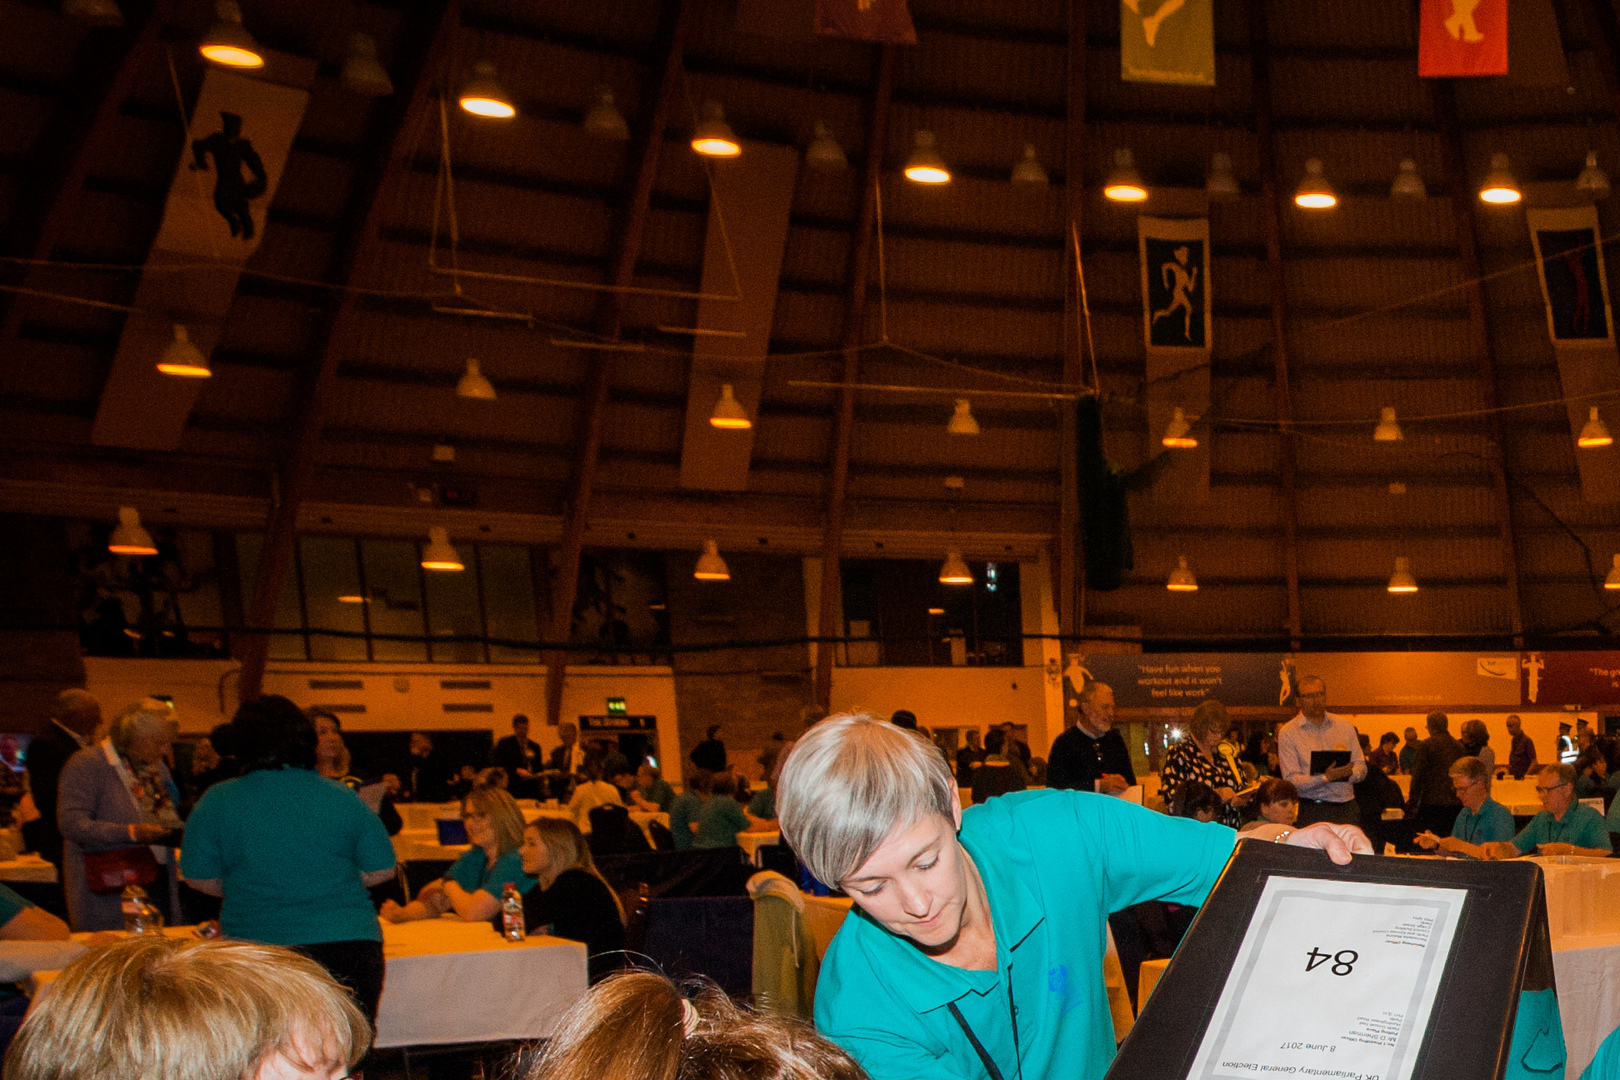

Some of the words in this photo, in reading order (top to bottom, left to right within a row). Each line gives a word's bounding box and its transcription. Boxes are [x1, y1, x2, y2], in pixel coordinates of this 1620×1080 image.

[1165, 664, 1180, 674] fun
[1181, 664, 1204, 673] when
[1205, 665, 1221, 675] you
[1137, 676, 1173, 686] workout
[1174, 676, 1190, 686] and
[1191, 677, 1198, 686] it
[1611, 679, 1620, 688] is
[1151, 688, 1166, 698] feel
[1168, 688, 1184, 698] like
[1301, 945, 1358, 977] 84
[1280, 1040, 1303, 1050] 2017
[1305, 1042, 1328, 1052] June
[1329, 1044, 1336, 1052] 8
[1221, 1060, 1258, 1071] Election
[1260, 1063, 1296, 1075] General
[1298, 1065, 1363, 1080] Parliamentary
